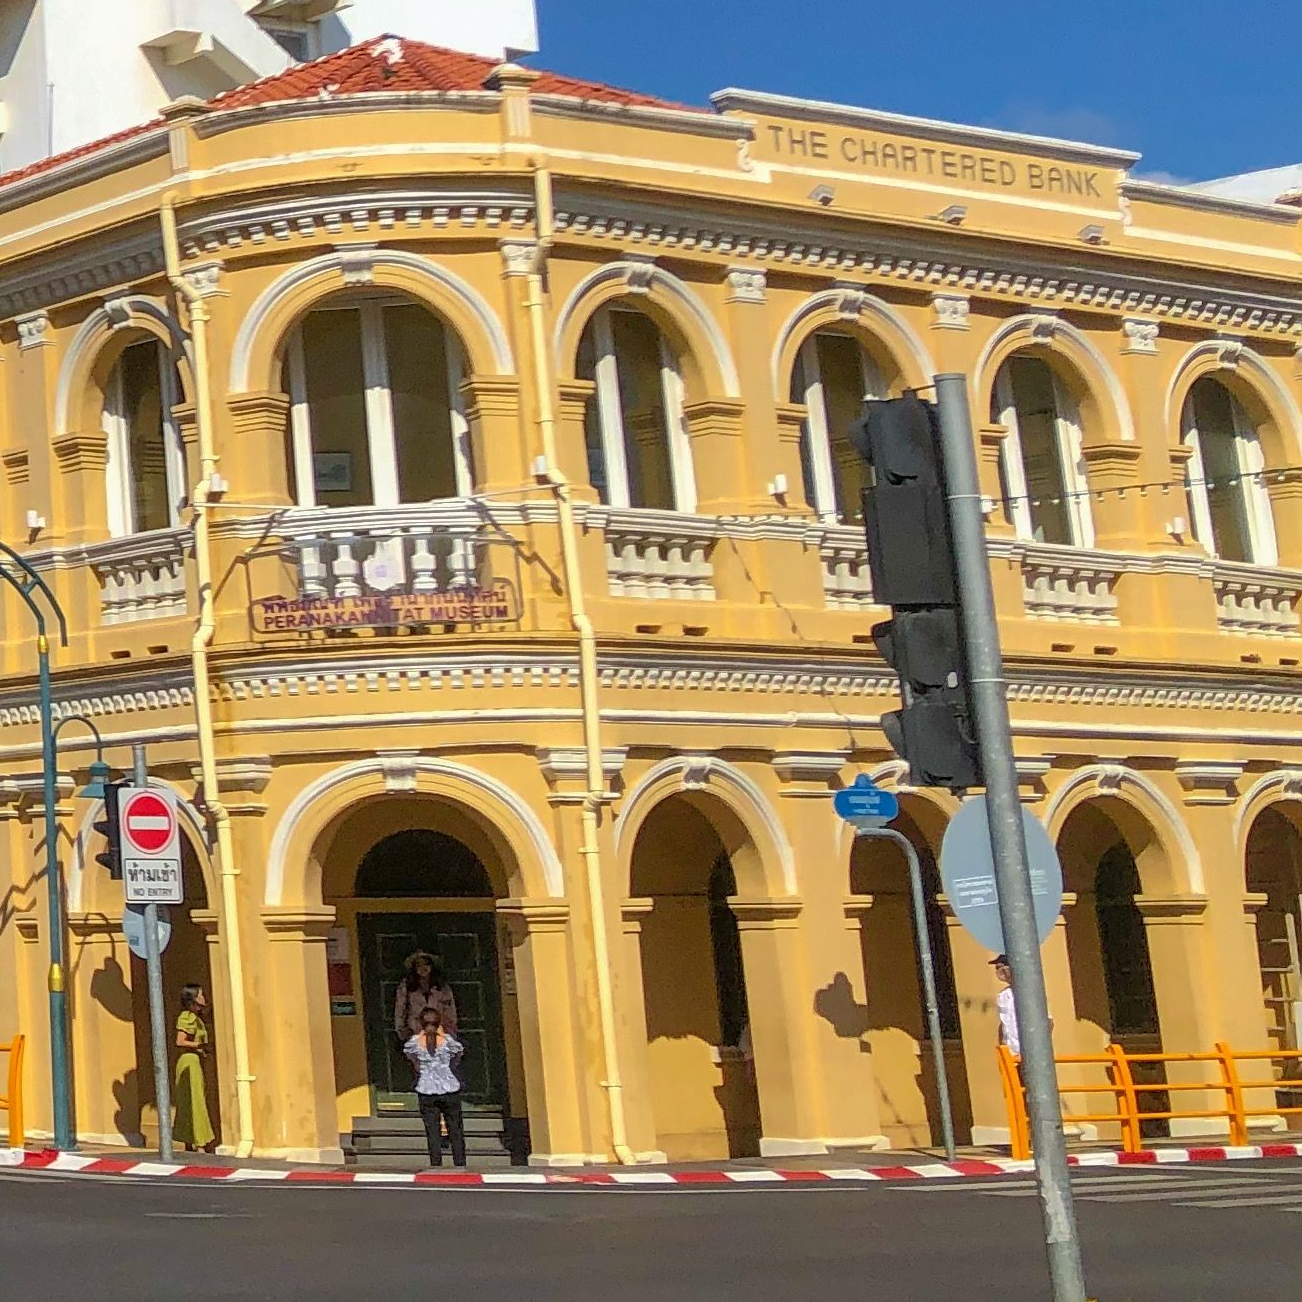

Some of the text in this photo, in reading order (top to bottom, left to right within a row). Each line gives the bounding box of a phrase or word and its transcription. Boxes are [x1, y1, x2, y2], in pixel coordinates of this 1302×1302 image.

[766, 124, 1101, 198] THE CHARTERED BANK
[430, 604, 509, 620] MUSEUM
[128, 862, 177, 882] ห้ามเข้า
[133, 888, 173, 897] NO ENTRY
